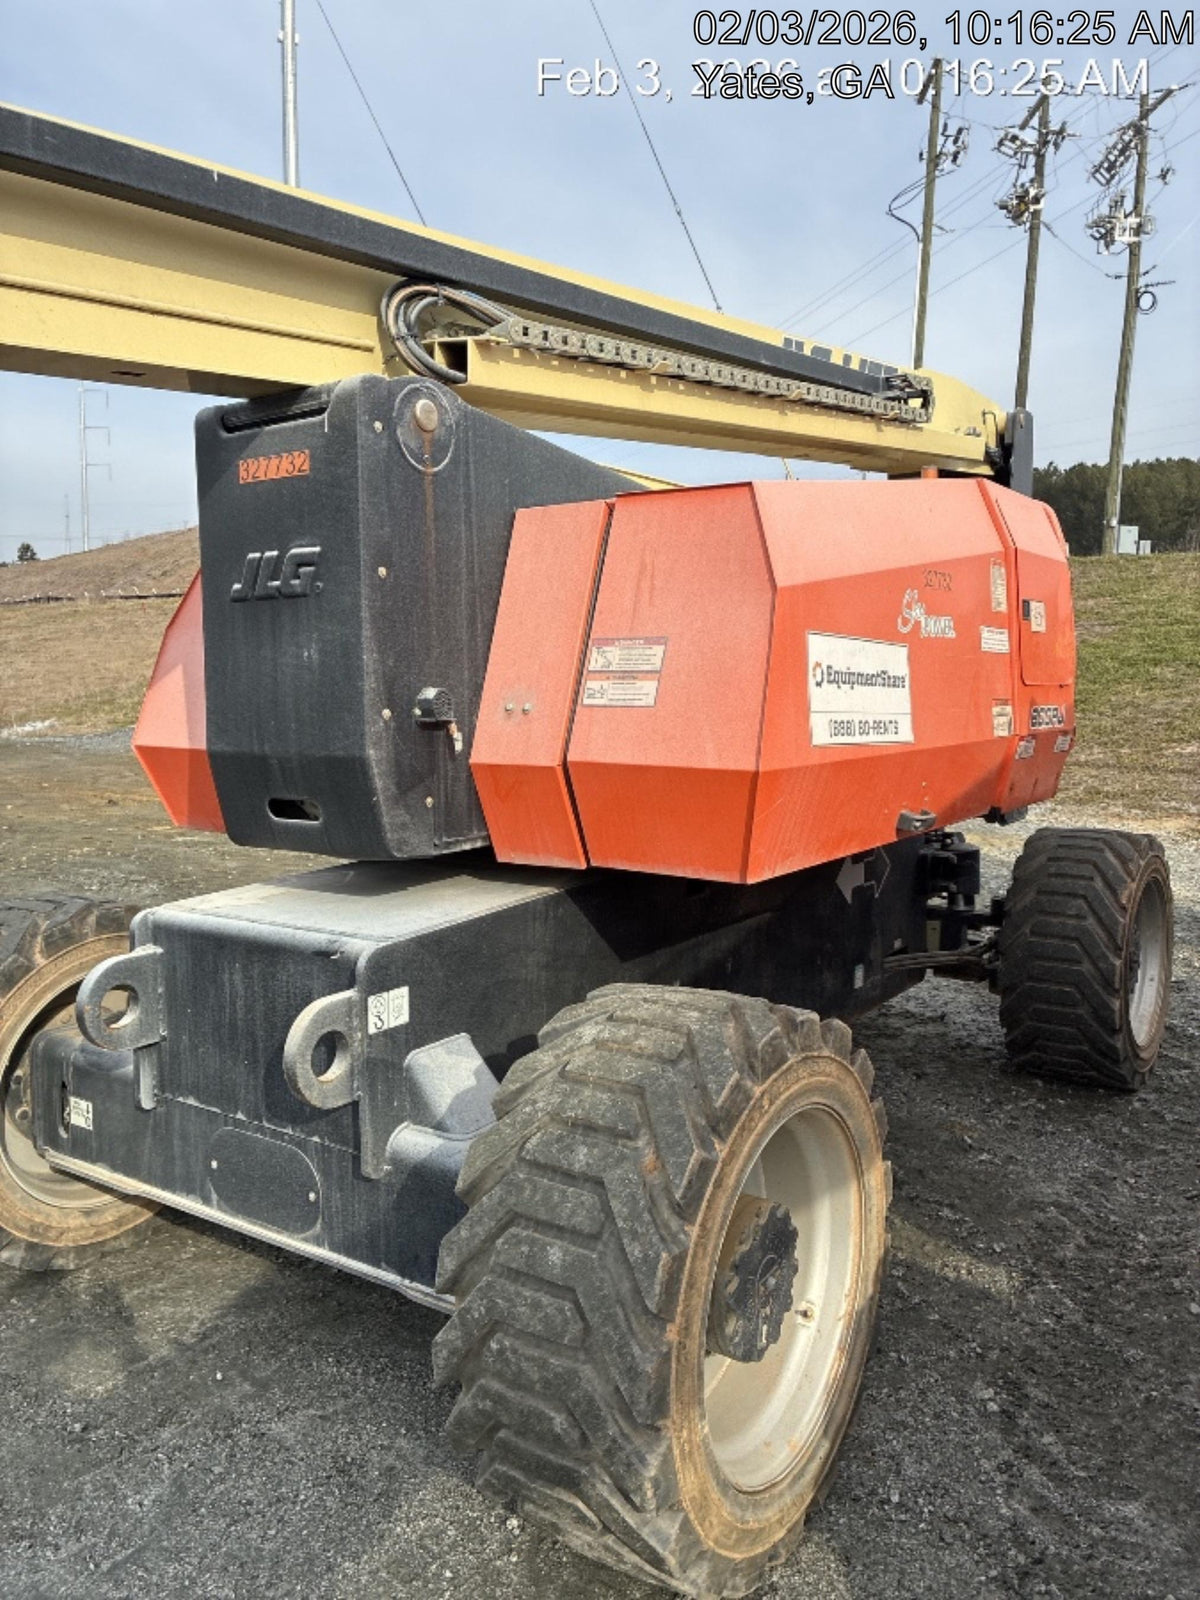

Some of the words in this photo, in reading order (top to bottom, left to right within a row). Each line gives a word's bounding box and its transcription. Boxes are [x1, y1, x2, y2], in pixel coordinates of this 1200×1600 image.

[240, 450, 309, 482] 327732
[230, 545, 322, 602] JLG
[826, 664, 907, 690] EquipmentShare
